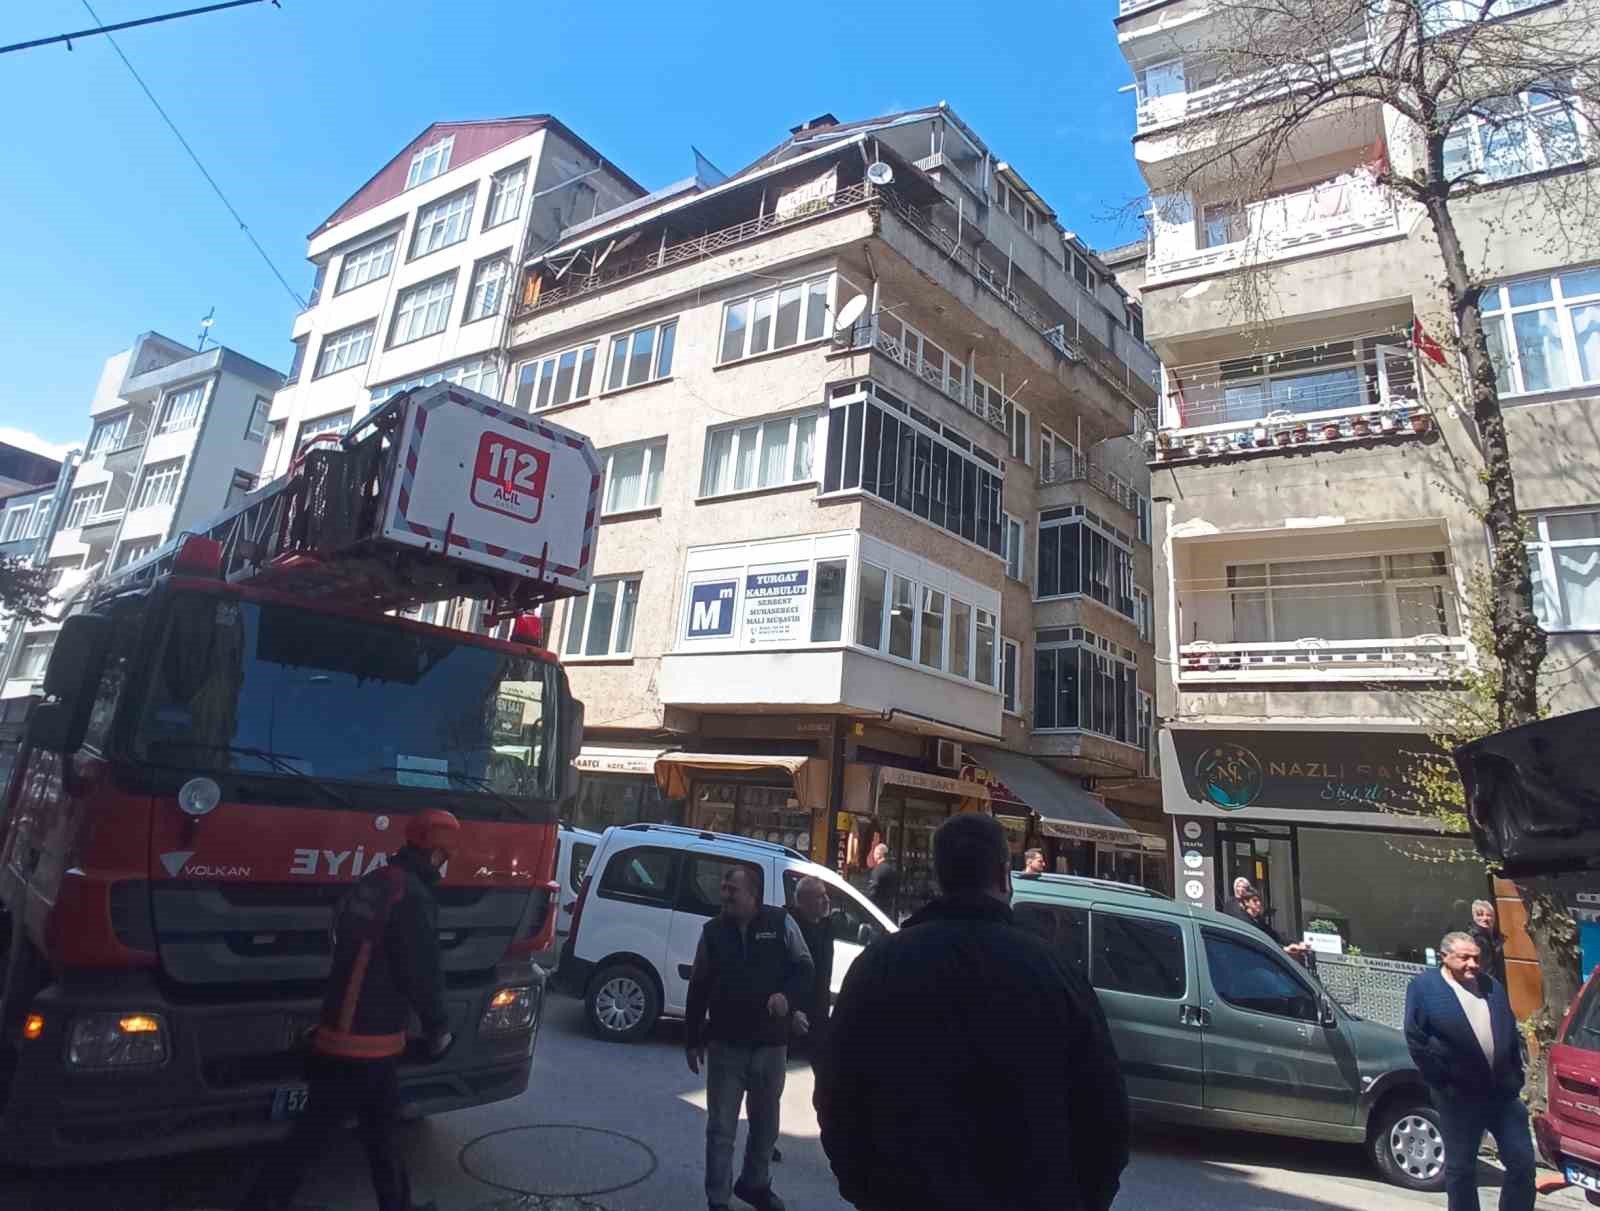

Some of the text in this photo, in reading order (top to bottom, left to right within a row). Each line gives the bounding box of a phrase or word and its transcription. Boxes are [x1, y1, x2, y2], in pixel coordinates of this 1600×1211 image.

[489, 442, 539, 490] 112
[719, 587, 734, 599] m
[691, 599, 722, 631] M
[185, 865, 251, 877] VOLKAN
